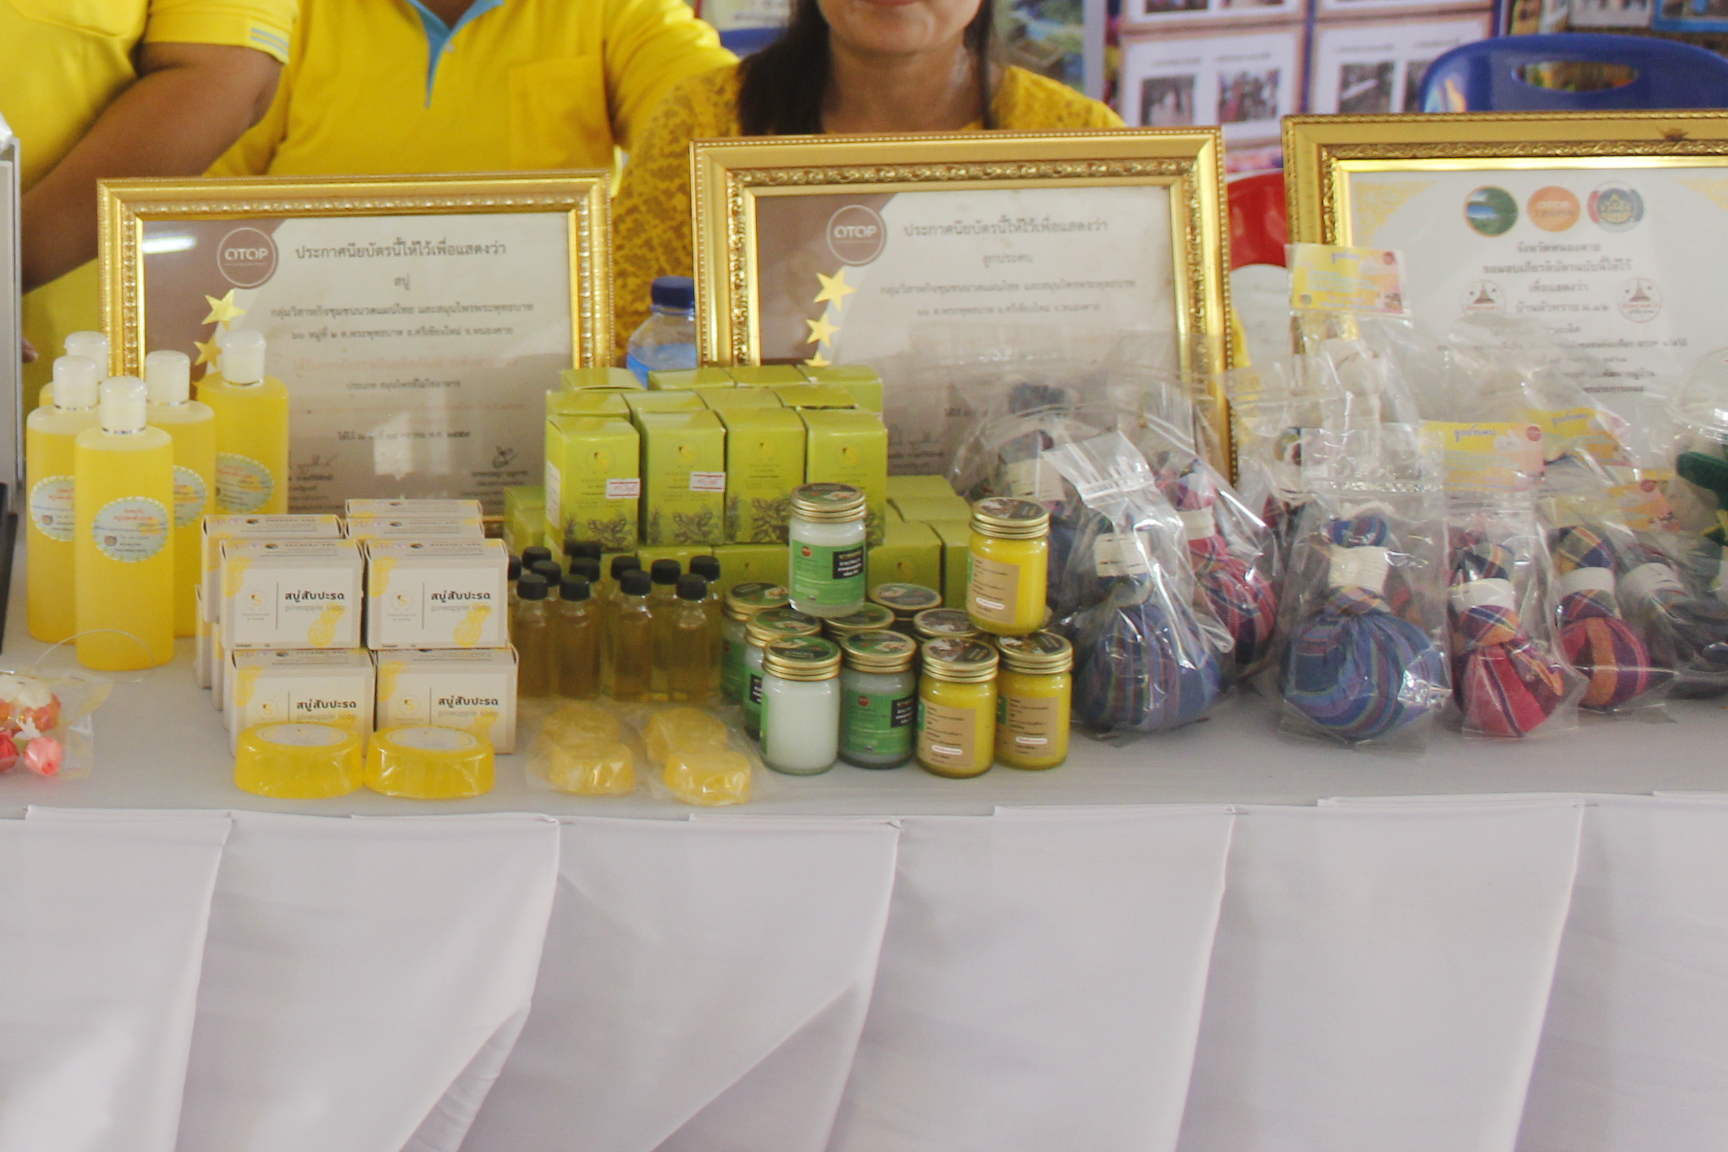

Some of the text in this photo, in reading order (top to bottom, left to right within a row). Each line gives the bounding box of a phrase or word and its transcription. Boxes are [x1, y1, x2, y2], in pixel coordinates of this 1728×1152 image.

[834, 225, 877, 238] OTOP
[225, 248, 268, 261] OTOP
[285, 589, 345, 603] สบู่สับปะรด
[431, 589, 491, 603] สบู่สับปะรด
[297, 698, 357, 712] สบู่สับปะรด
[438, 695, 499, 709] สบู่สับปะรด
